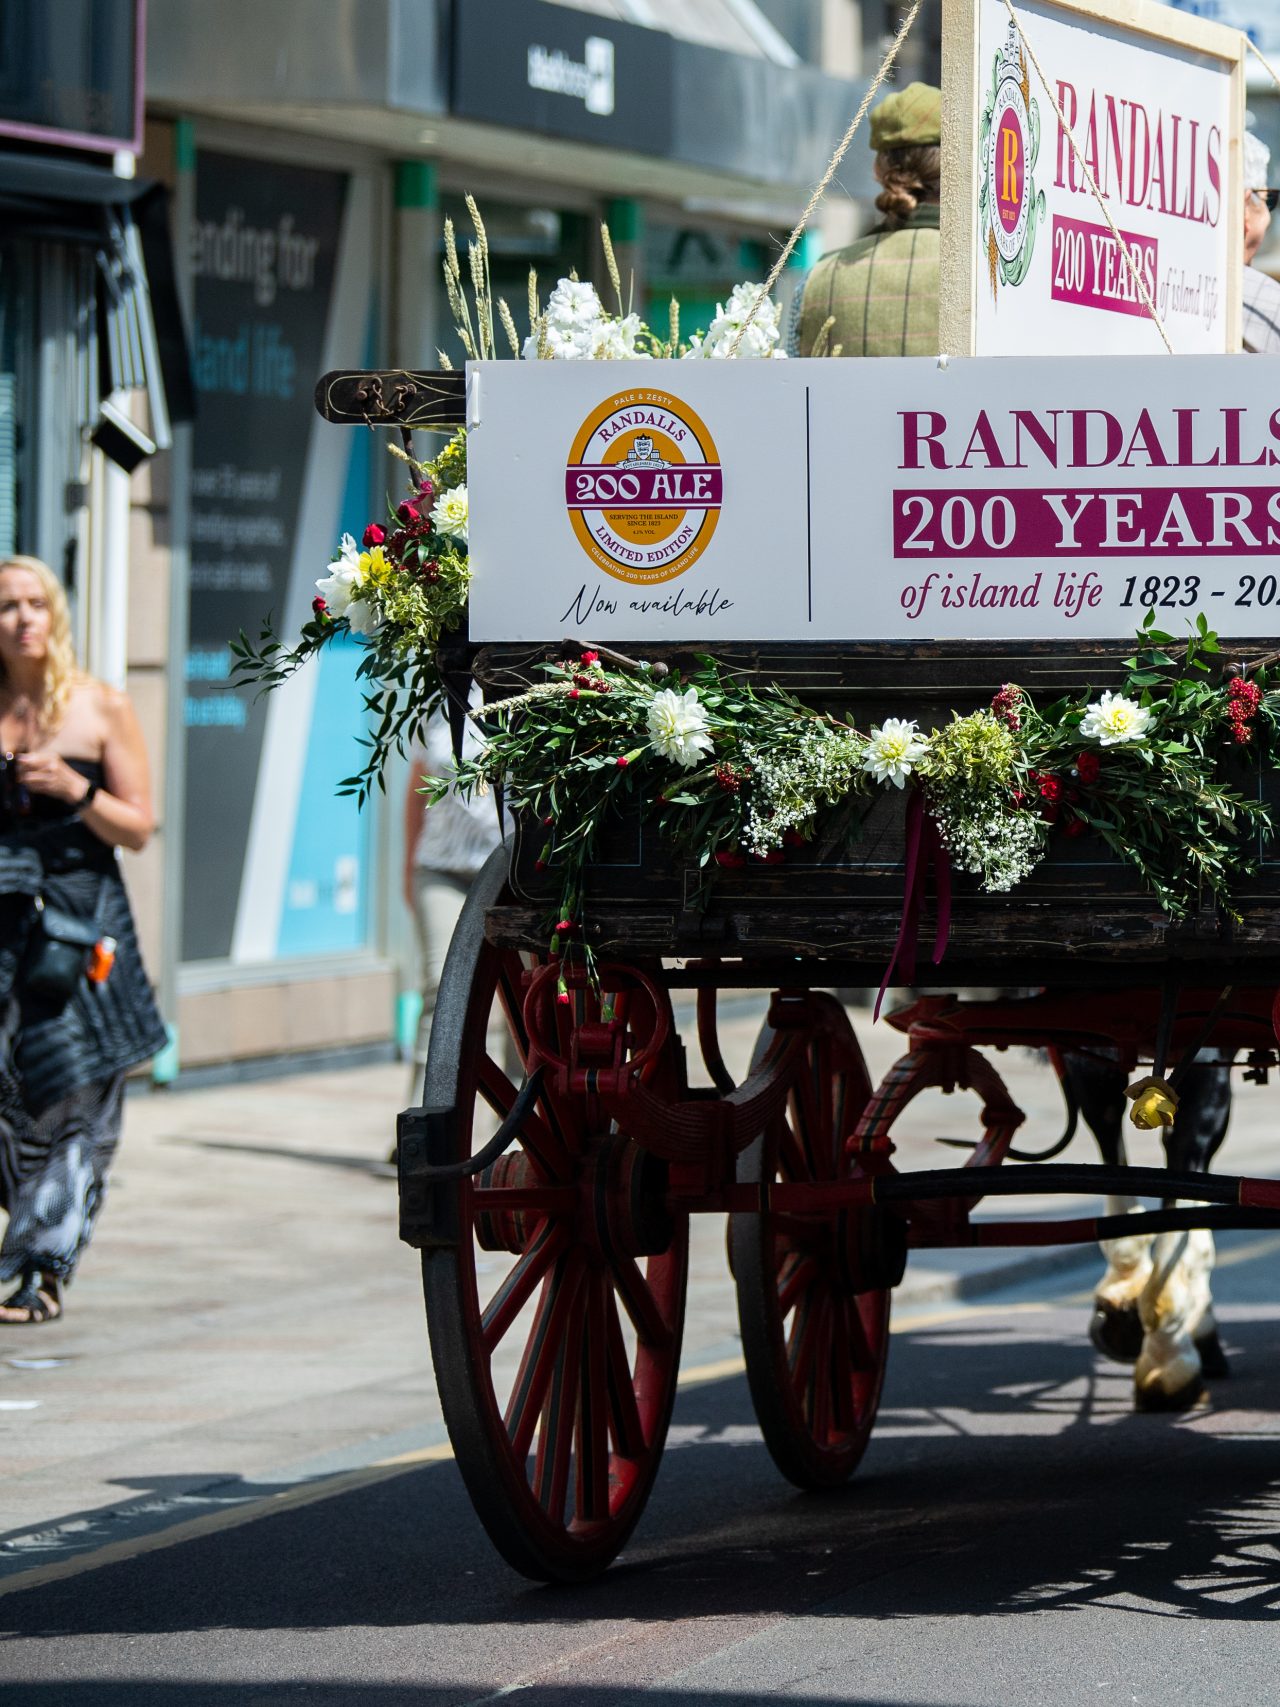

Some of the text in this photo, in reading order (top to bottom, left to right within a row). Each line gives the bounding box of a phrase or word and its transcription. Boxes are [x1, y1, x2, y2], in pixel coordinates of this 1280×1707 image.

[1001, 127, 1019, 205] R
[1053, 79, 1222, 229] RANDALLS
[1054, 226, 1086, 293] 200
[1160, 267, 1172, 322] of
[1171, 268, 1202, 316] island
[614, 394, 635, 406] PALE
[646, 393, 673, 406] ZESTY
[597, 411, 687, 443] RANDALLS
[576, 473, 712, 500] 200 ALE
[595, 525, 694, 562] LIMITED EDITION
[902, 495, 1017, 551] 200
[591, 547, 625, 576] CELEBRATING
[639, 572, 660, 580] YEARS
[669, 558, 689, 573] ISLAND
[689, 546, 699, 559] LIFE
[560, 584, 735, 625] Now available
[900, 573, 941, 619] of
[940, 572, 1044, 608] island
[1053, 571, 1103, 618] life
[1119, 575, 1201, 608] 1823
